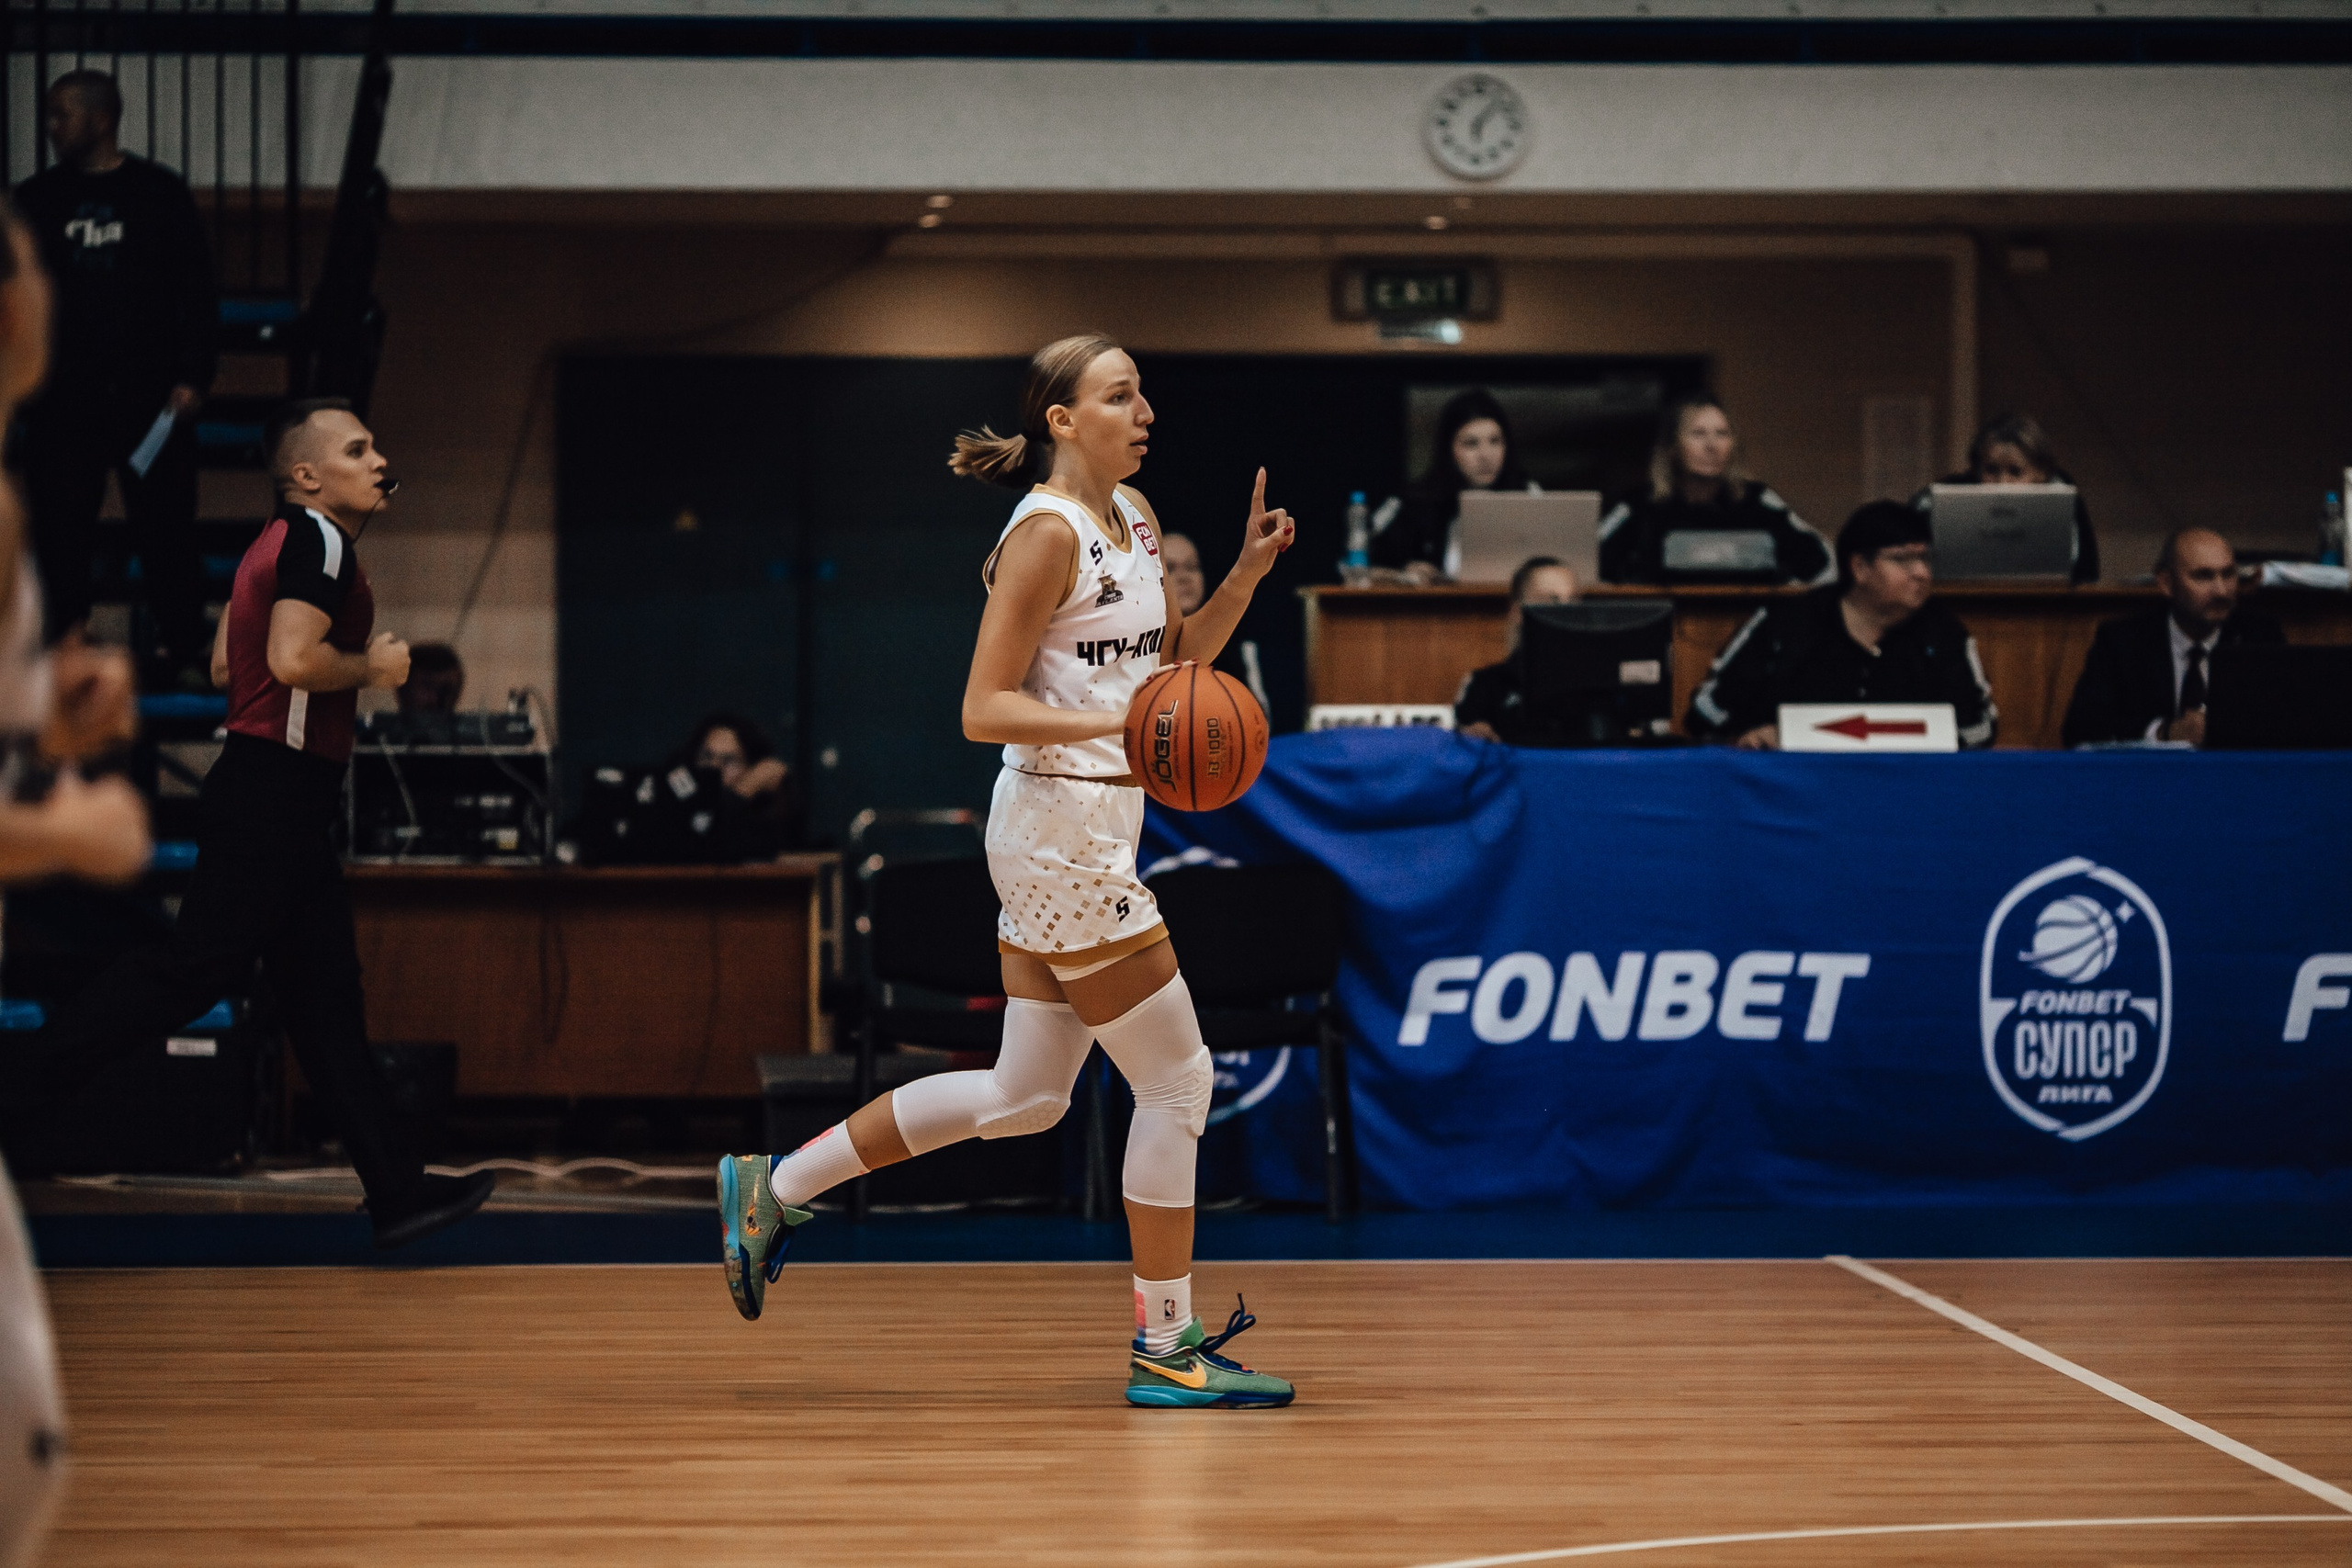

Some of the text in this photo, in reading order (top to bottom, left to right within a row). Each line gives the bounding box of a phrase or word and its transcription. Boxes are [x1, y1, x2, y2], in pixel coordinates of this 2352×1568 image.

[1206, 716, 1221, 756] 1000
[1396, 949, 1872, 1047] FONBET
[2018, 988, 2132, 1015] FONBET
[2037, 1084, 2114, 1104] ЛИГА
